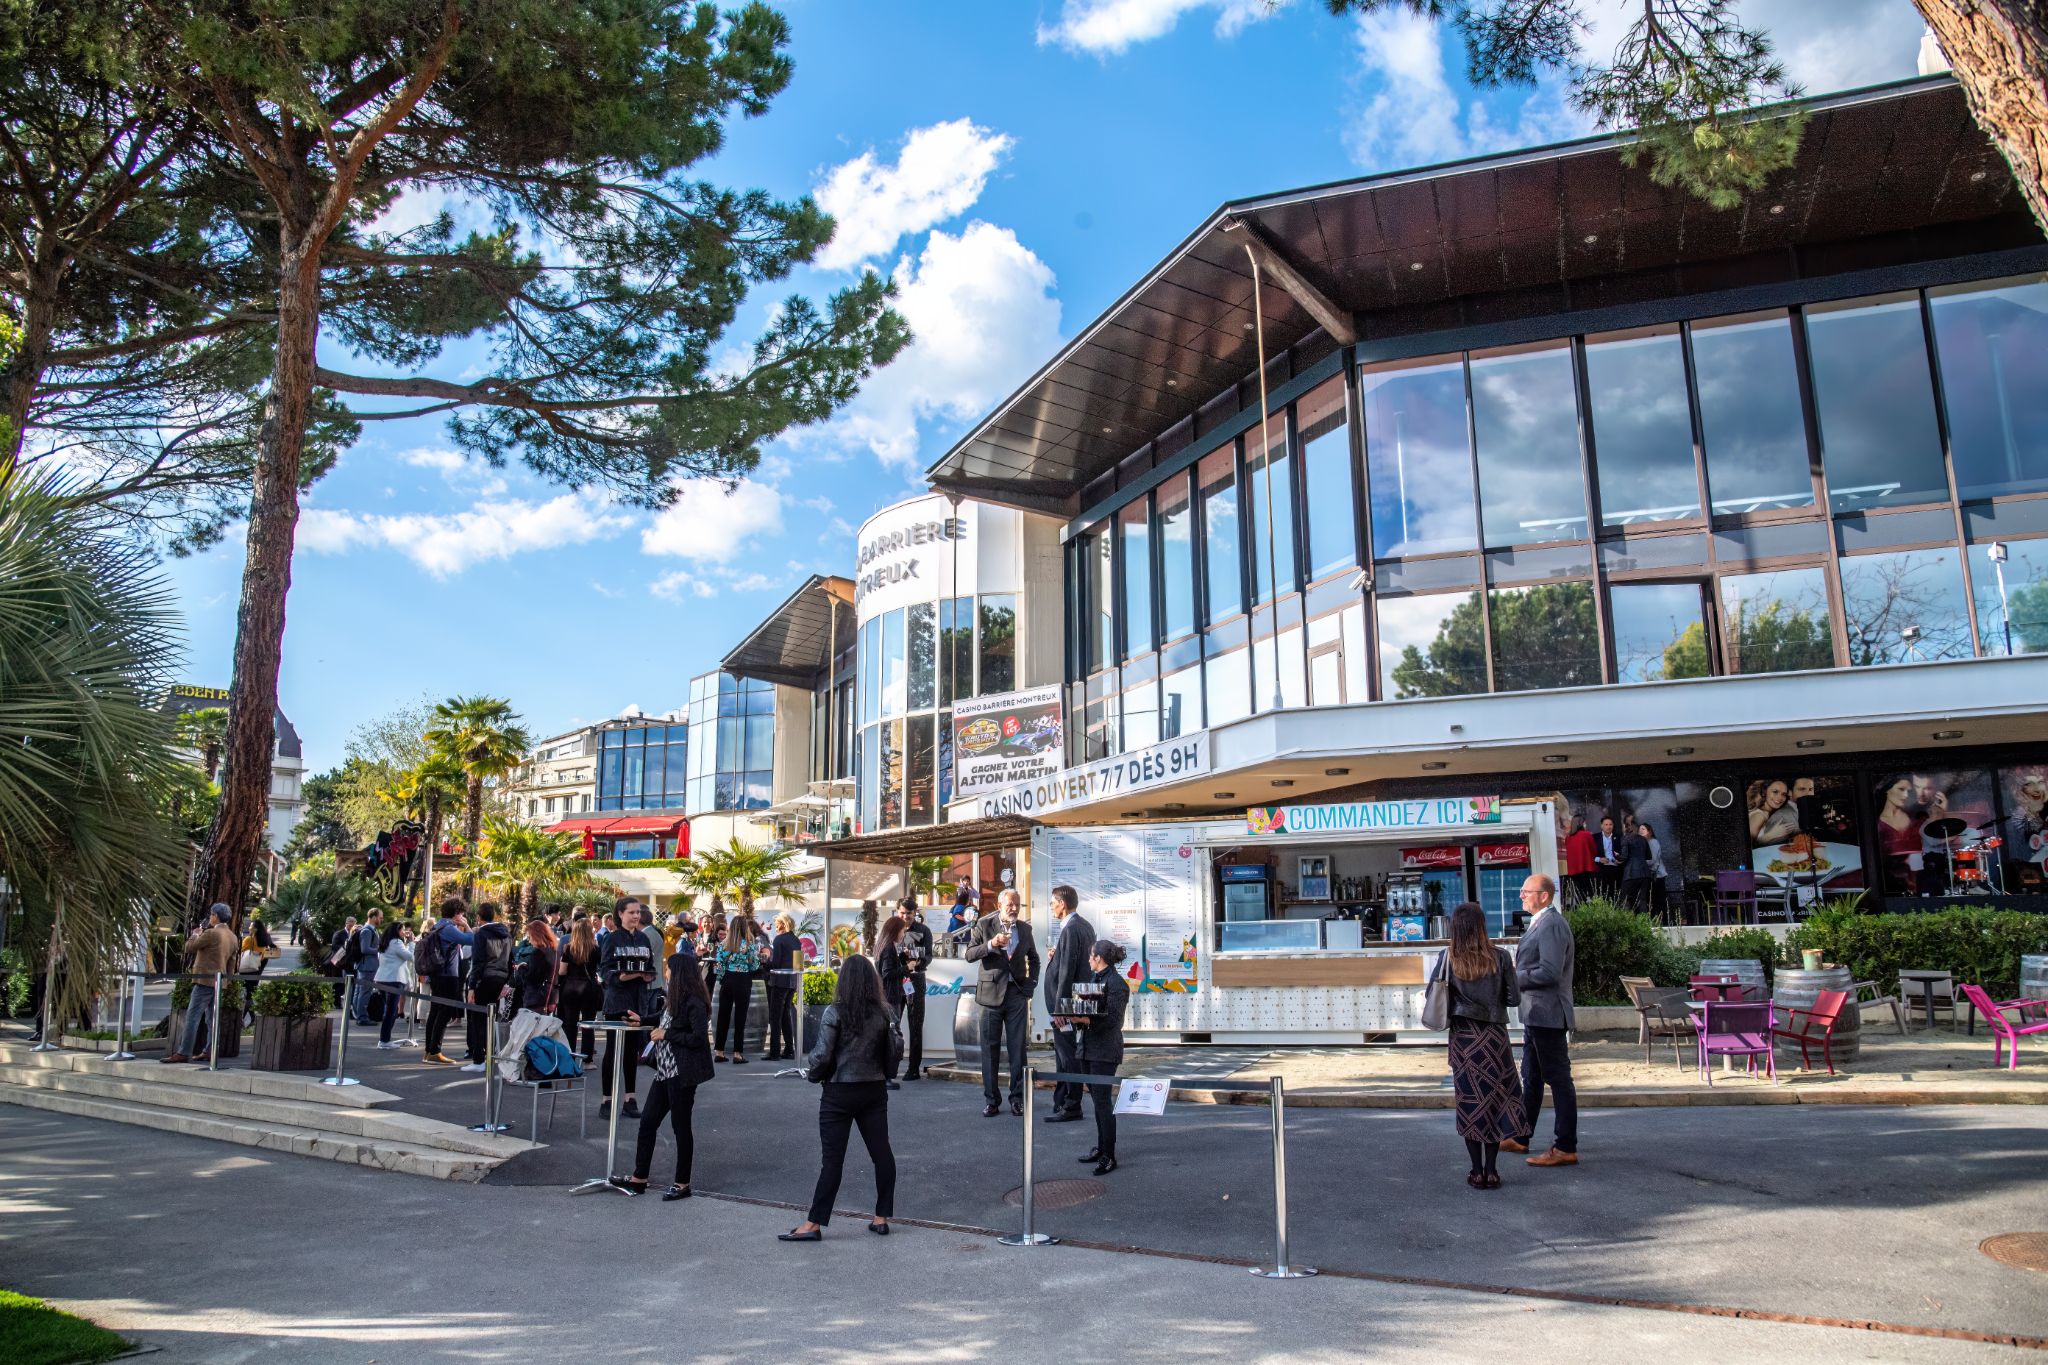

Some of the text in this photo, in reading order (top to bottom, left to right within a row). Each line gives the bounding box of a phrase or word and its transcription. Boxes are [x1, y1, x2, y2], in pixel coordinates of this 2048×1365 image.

[175, 685, 215, 699] EDEN
[956, 704, 982, 714] CASINO
[1016, 692, 1057, 705] MONTREUX
[960, 766, 1058, 787] ASTON MARTIN
[971, 758, 1045, 774] GAGNEZ VOTRE
[984, 743, 1199, 818] CASINO OUVERT 7/7 DÈS 9H
[1289, 800, 1465, 831] COMMANDEZ ICI
